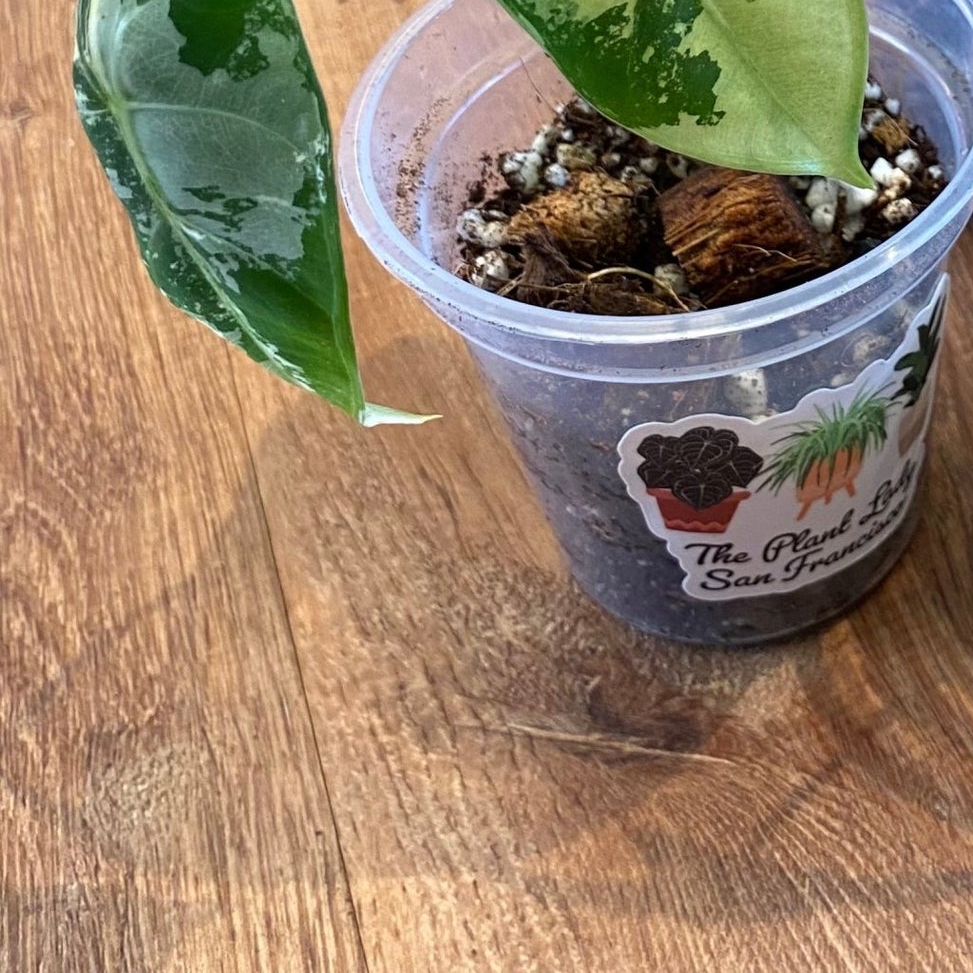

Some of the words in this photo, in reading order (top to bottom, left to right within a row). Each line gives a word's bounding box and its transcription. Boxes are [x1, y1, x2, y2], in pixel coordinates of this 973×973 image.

[685, 543, 751, 566] The
[763, 508, 854, 563] Plant
[859, 458, 917, 526] Lady
[700, 568, 776, 591] San
[782, 497, 907, 582] Francisco
